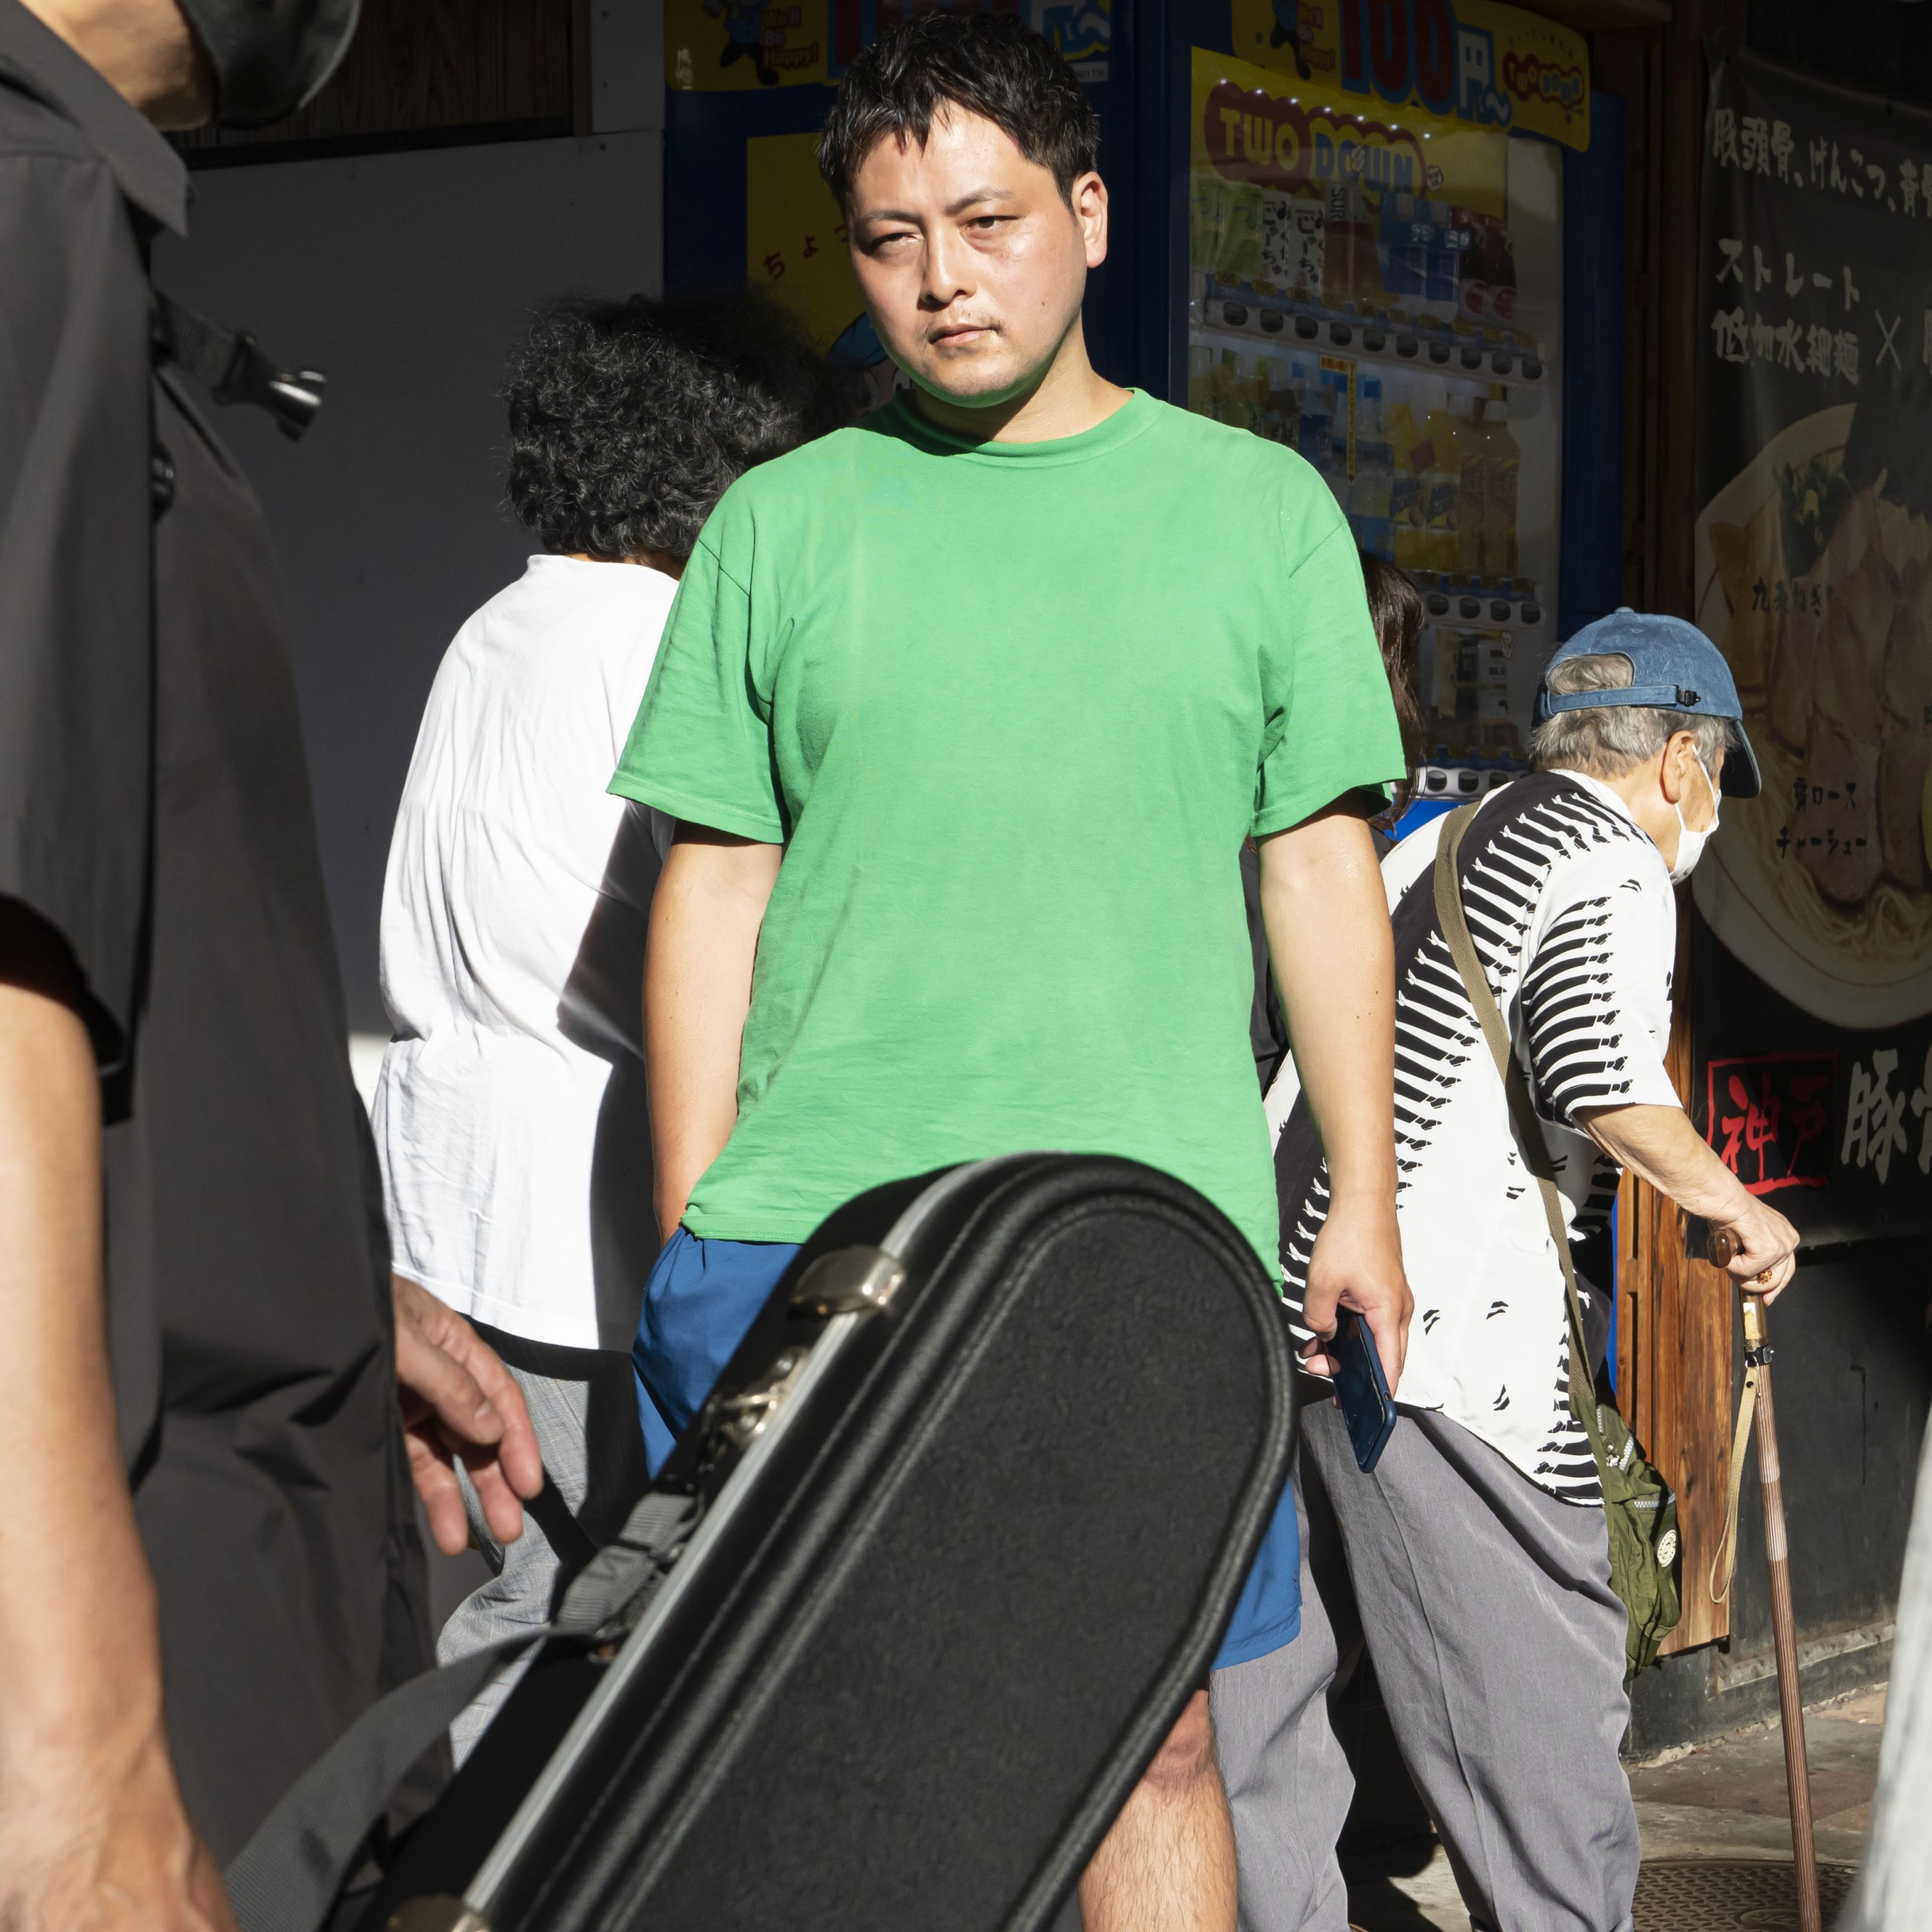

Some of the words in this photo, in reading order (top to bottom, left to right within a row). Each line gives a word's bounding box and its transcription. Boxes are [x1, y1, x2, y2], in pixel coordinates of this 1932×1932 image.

[764, 8, 800, 27] We'll
[764, 30, 785, 46] Be
[764, 45, 819, 68] Happy!
[1220, 106, 1300, 172] TWO
[1315, 132, 1413, 194] DOWN
[1715, 238, 1860, 312] ストレート
[1710, 306, 1860, 385] 低加水細麺
[1776, 825, 1867, 859] チャーシュー
[1720, 1069, 1831, 1181] 神戸
